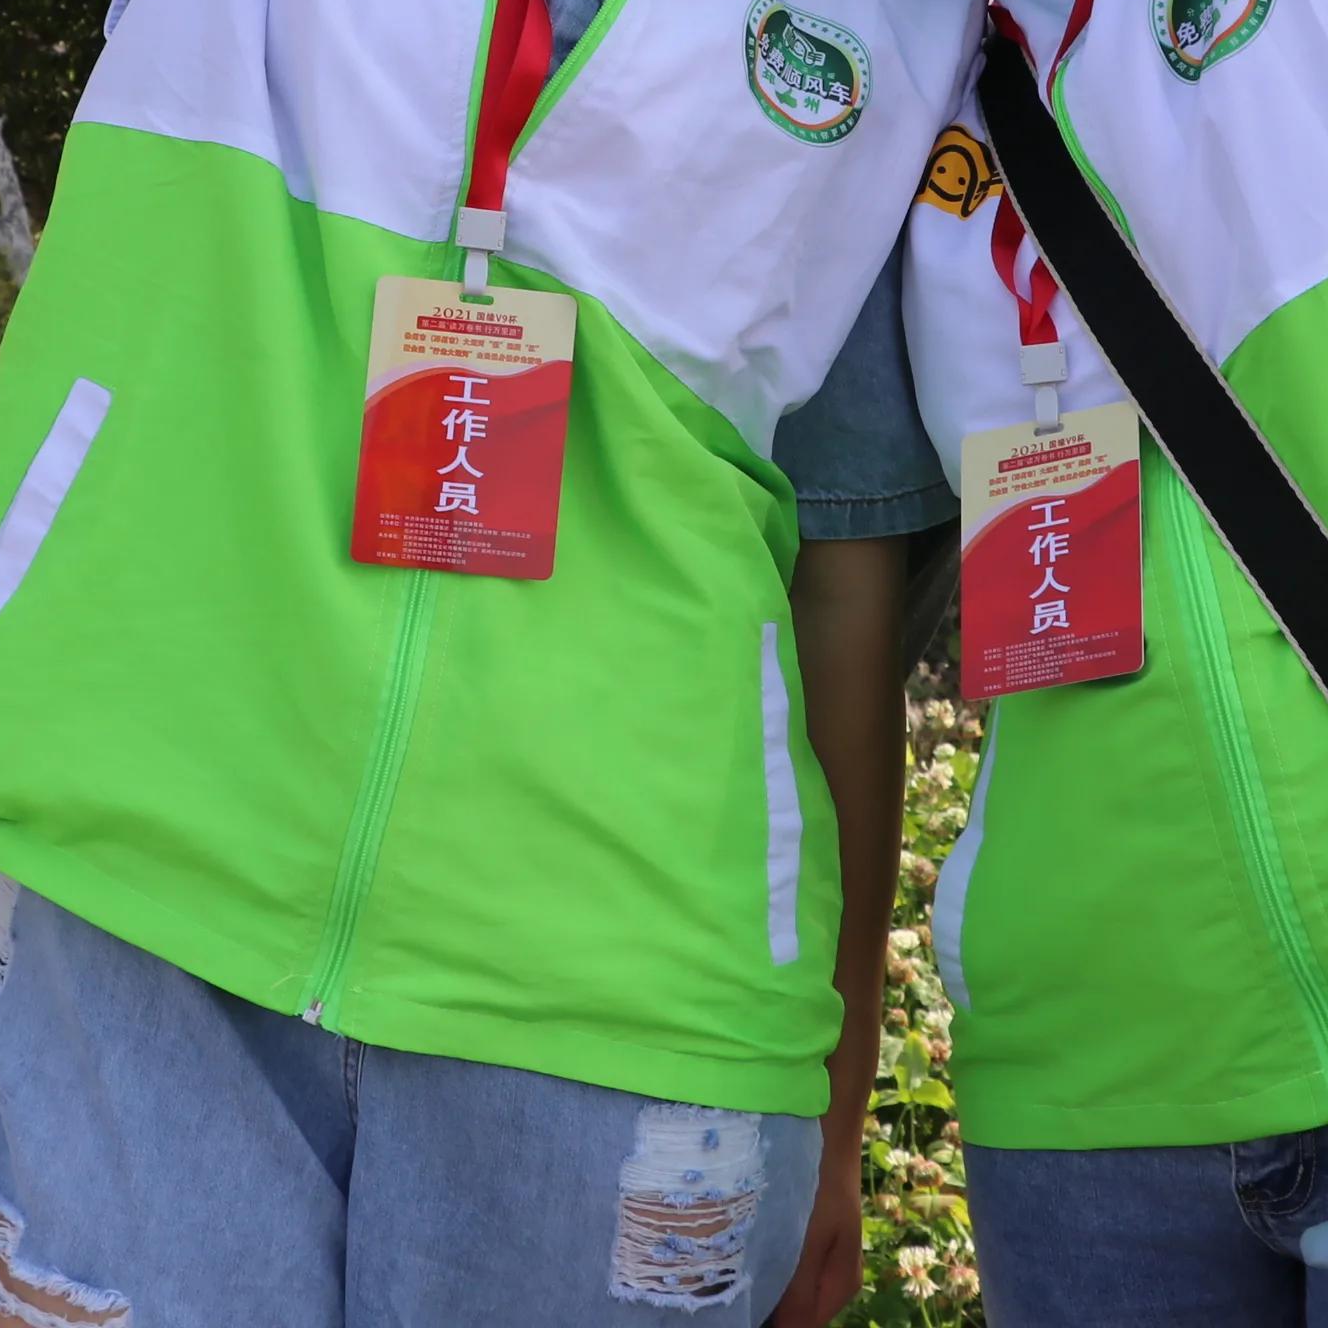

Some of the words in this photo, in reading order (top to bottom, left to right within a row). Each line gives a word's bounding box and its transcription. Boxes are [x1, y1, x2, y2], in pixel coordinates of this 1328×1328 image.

[432, 306, 472, 321] 2021
[433, 375, 491, 515] 工作人员
[1010, 441, 1045, 458] 2021
[1027, 499, 1071, 635] 工作人员
